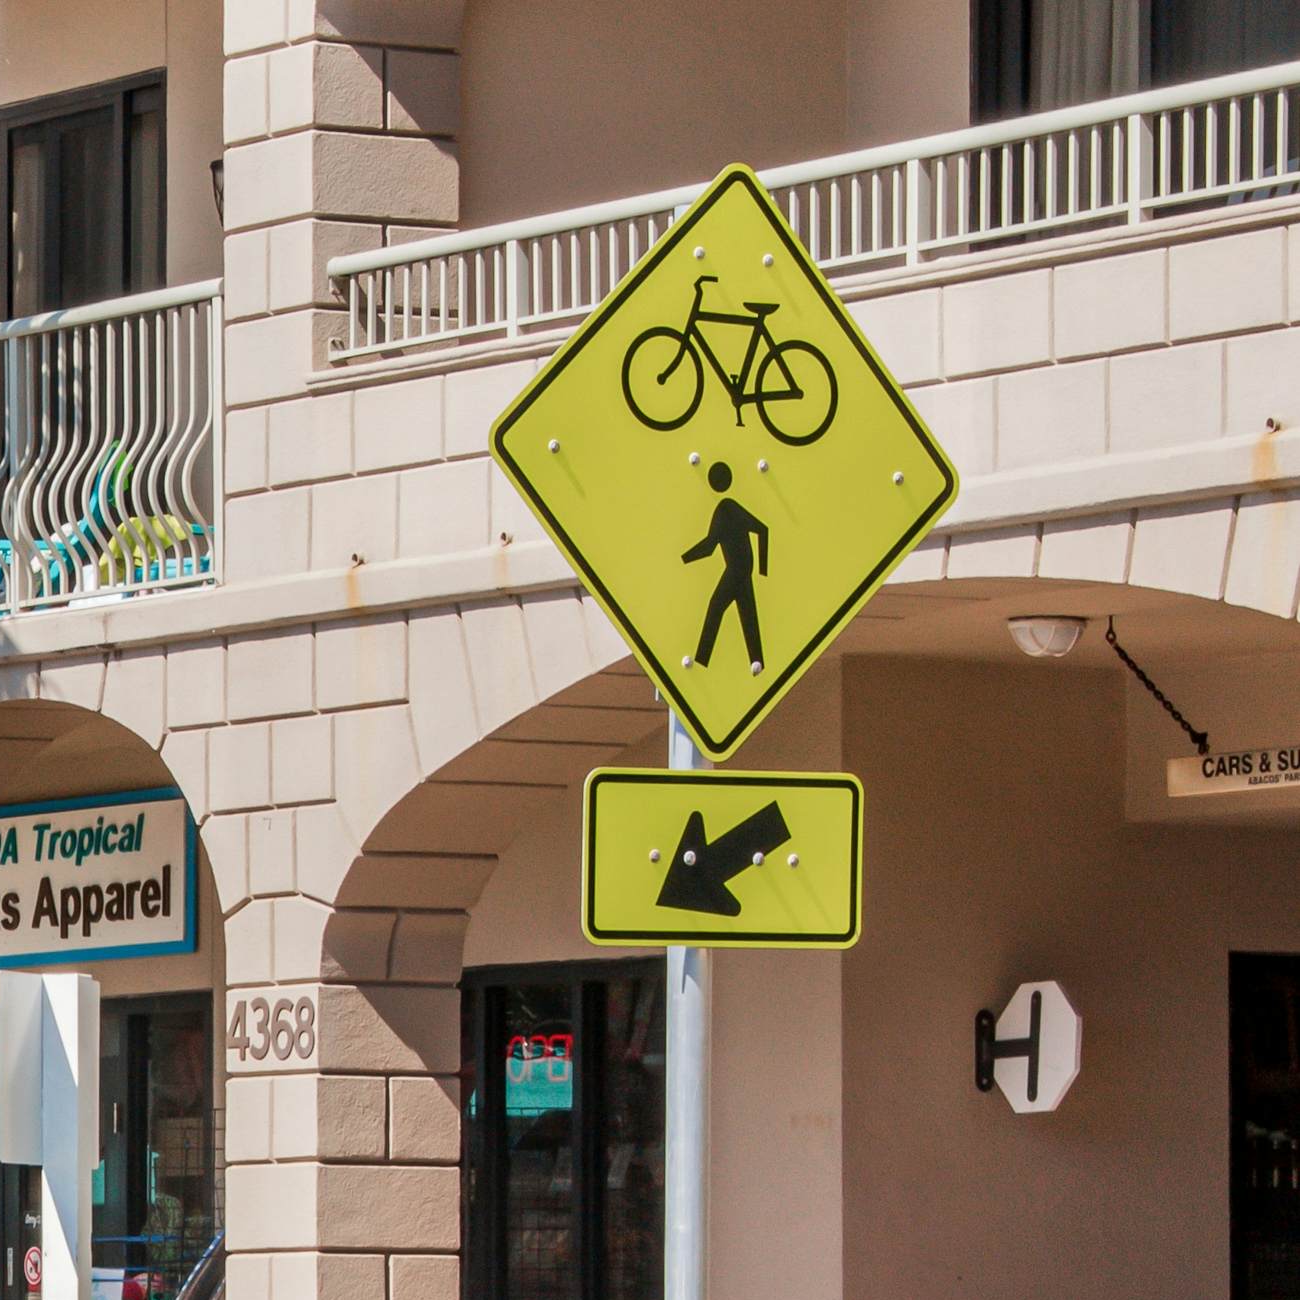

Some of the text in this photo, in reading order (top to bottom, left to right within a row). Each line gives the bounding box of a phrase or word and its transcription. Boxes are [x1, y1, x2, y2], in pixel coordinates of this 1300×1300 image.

[1202, 754, 1253, 778] CARS
[1259, 752, 1271, 773] &
[33, 813, 145, 866] Tropical
[32, 864, 171, 939] Apparel
[226, 996, 315, 1061] 4368
